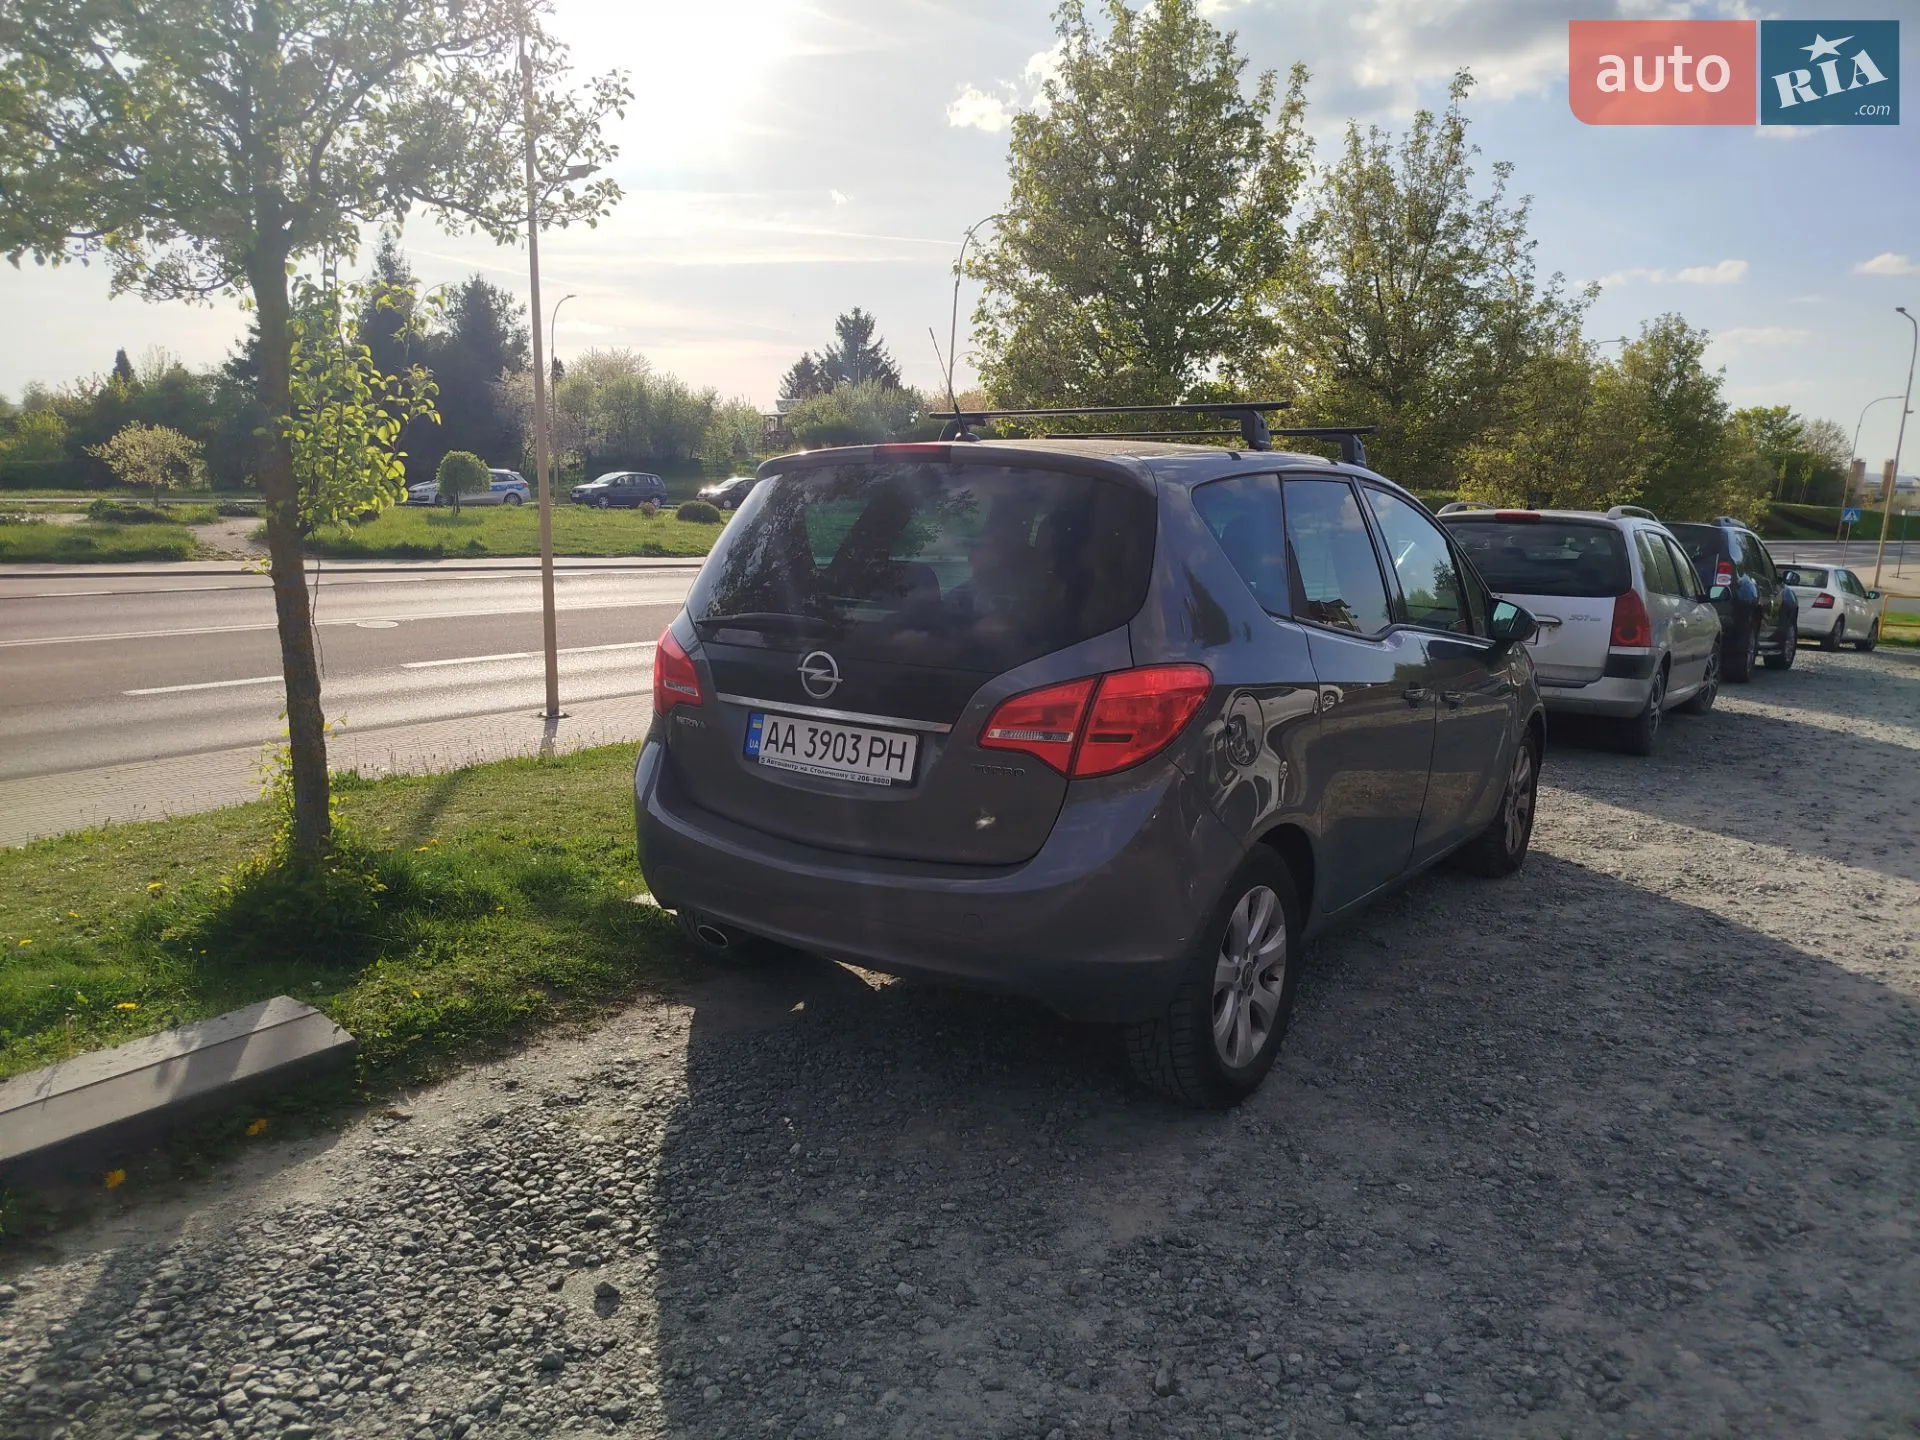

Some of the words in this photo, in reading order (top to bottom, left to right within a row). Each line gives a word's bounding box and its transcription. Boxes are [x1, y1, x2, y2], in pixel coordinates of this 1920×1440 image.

[749, 738, 759, 749] UA
[764, 721, 796, 756] AA
[804, 727, 863, 766] 3903
[866, 736, 908, 773] PH
